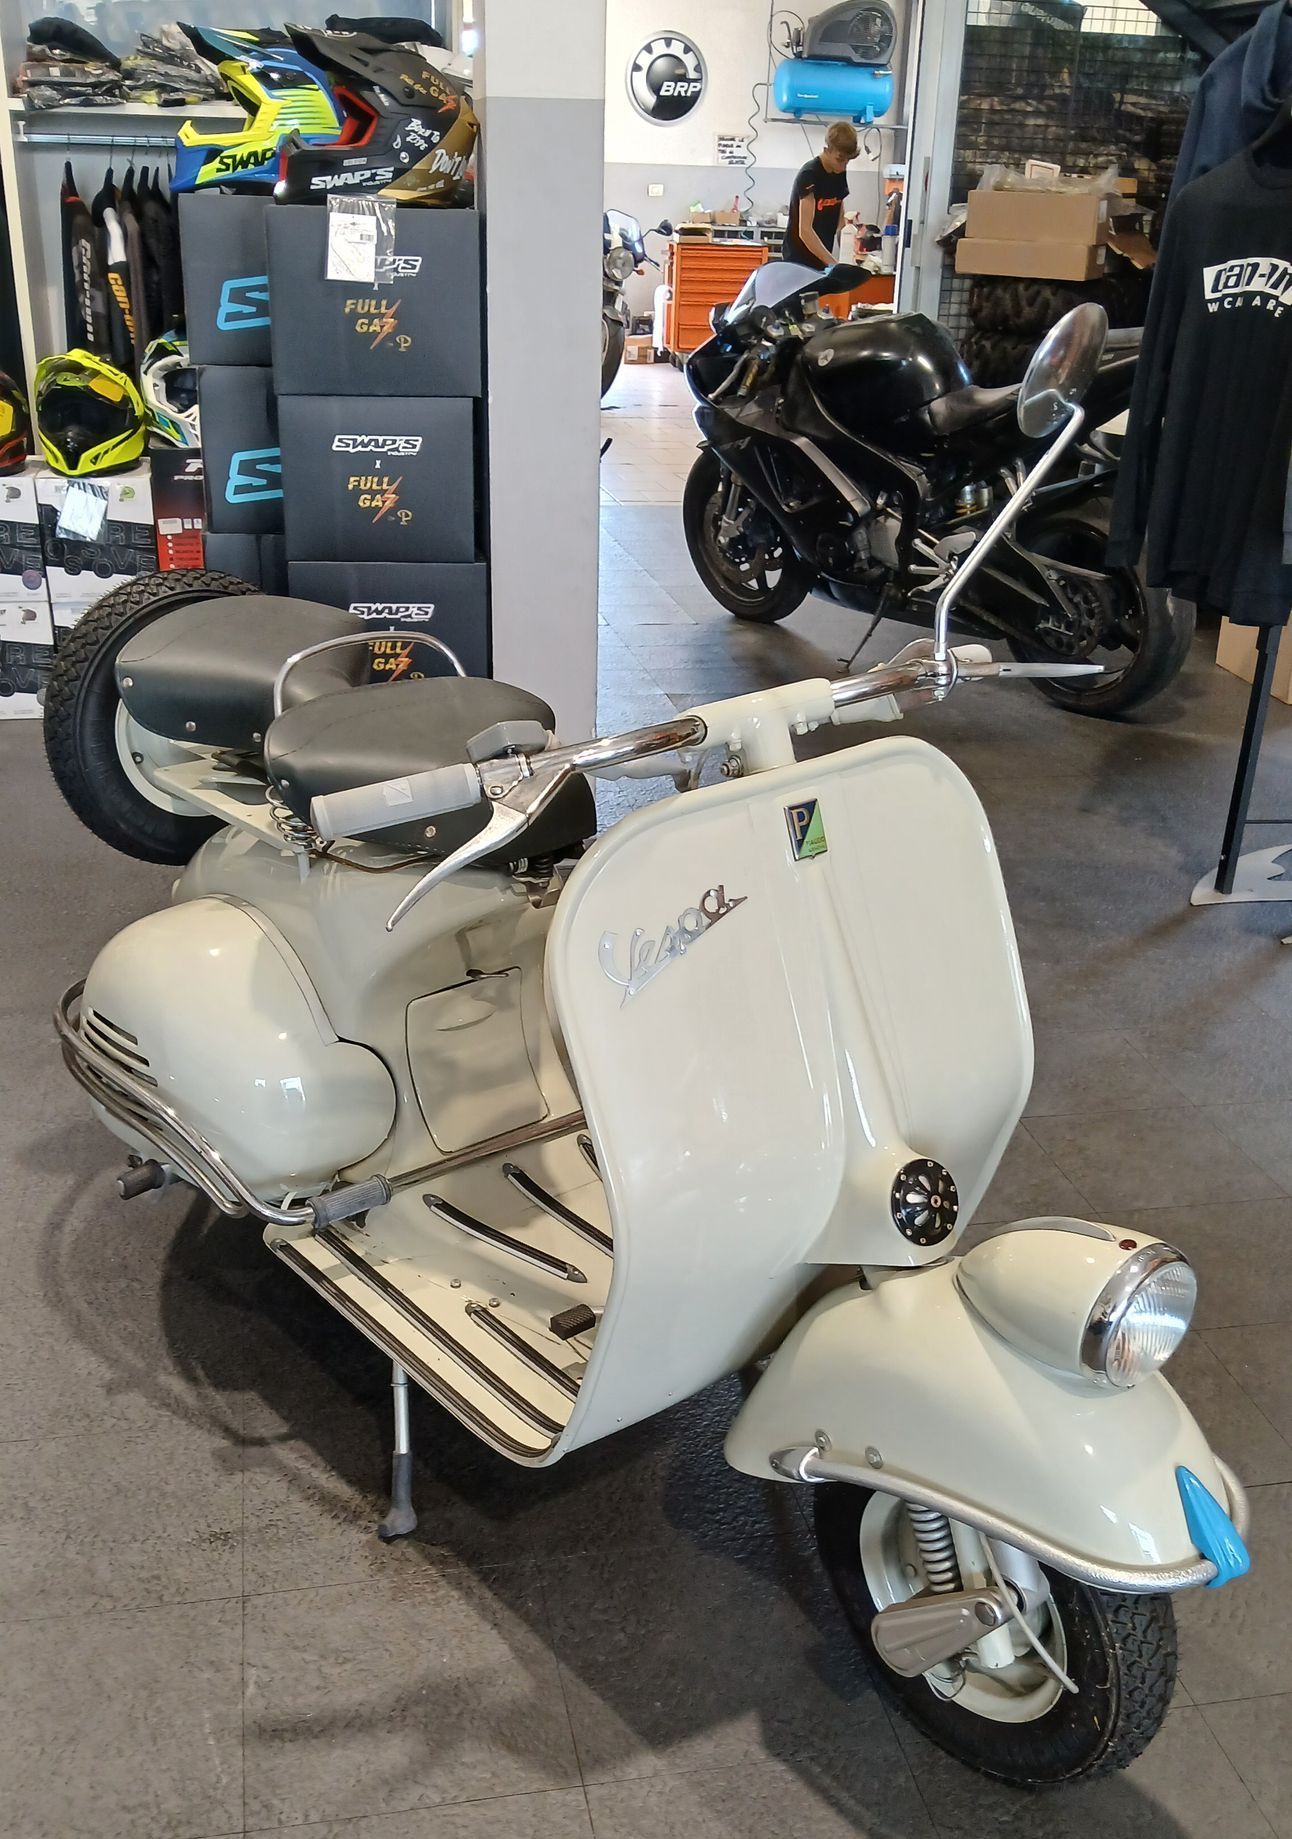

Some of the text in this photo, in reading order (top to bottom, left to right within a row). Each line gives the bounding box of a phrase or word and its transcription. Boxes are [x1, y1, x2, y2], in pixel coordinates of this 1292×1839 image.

[659, 81, 702, 97] BRP
[310, 167, 394, 190] SWAP'S
[345, 299, 390, 314] FULL
[332, 435, 422, 453] SWAP'S
[347, 476, 391, 491] FULL
[349, 603, 434, 619] SWAP'S
[791, 807, 811, 840] P
[598, 885, 748, 1008] Vespa
